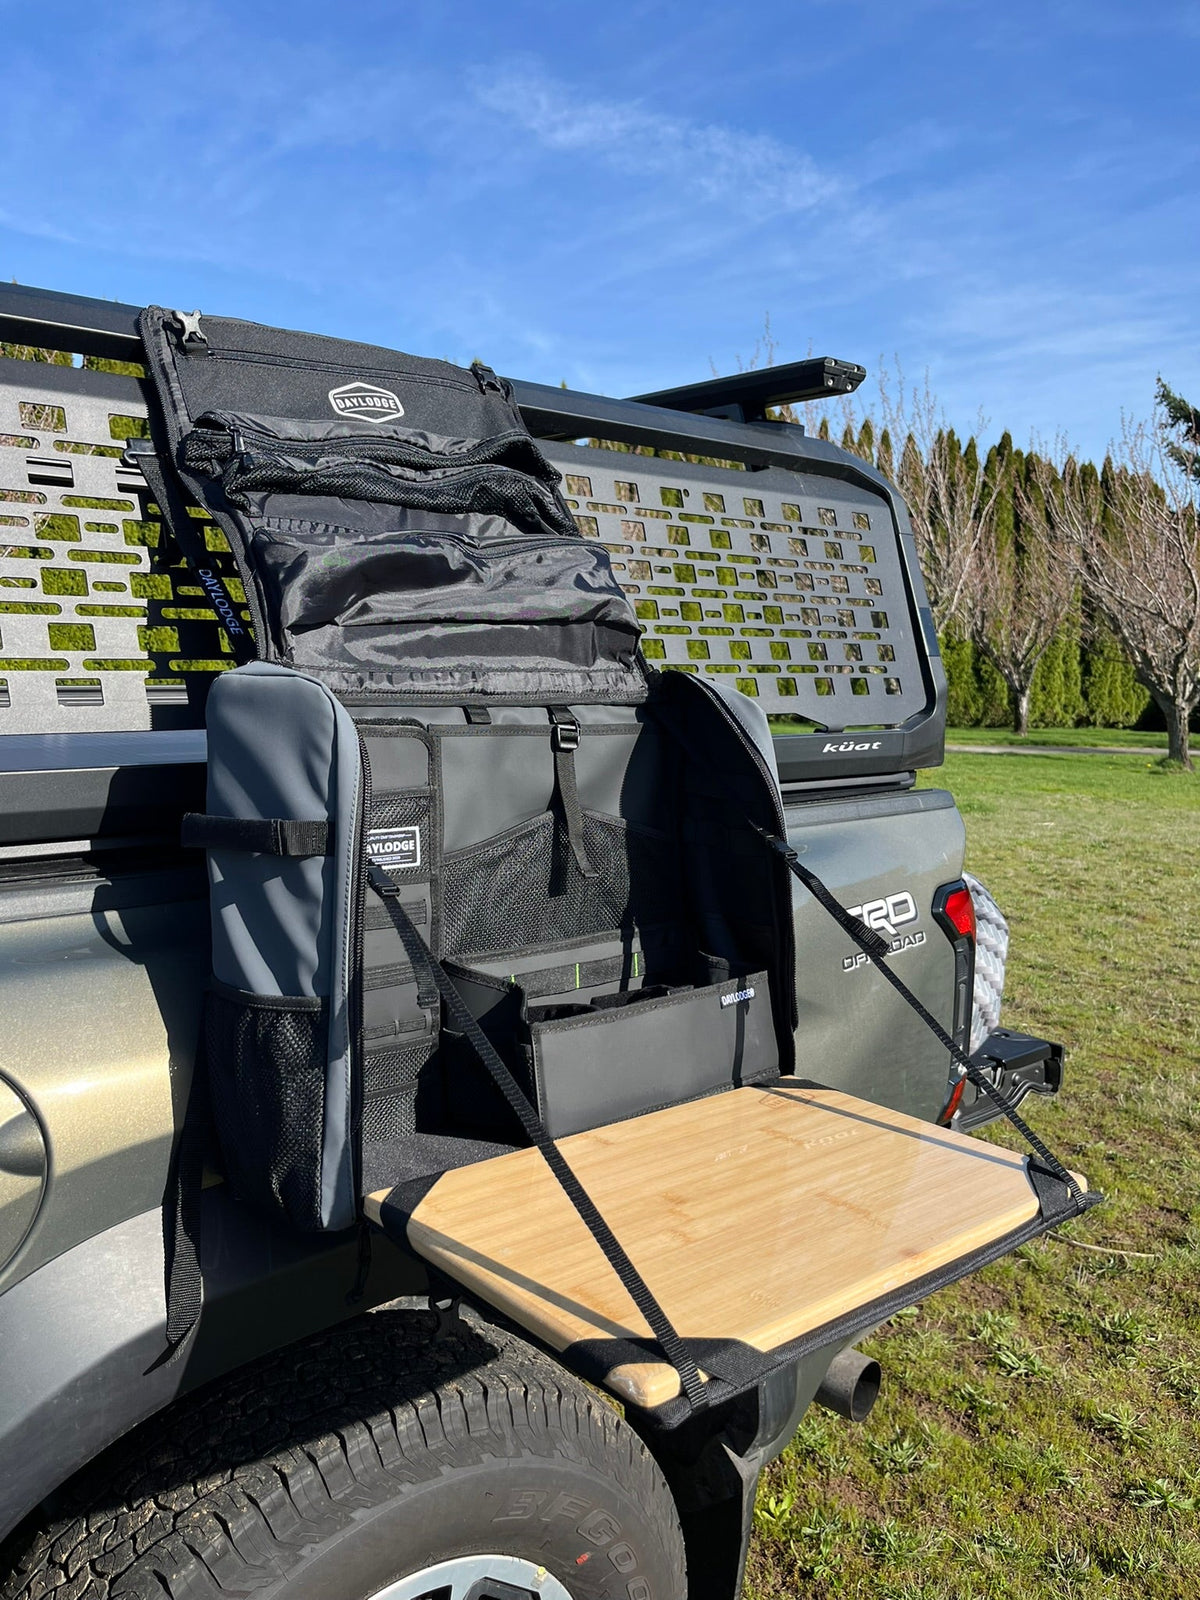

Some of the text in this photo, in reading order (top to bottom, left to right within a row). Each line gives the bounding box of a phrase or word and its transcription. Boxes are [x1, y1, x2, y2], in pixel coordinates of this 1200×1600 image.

[335, 396, 397, 409] DAYLODGE
[198, 568, 244, 635] DAYLODGE
[822, 741, 882, 753] küat
[366, 840, 416, 854] AYLODGE
